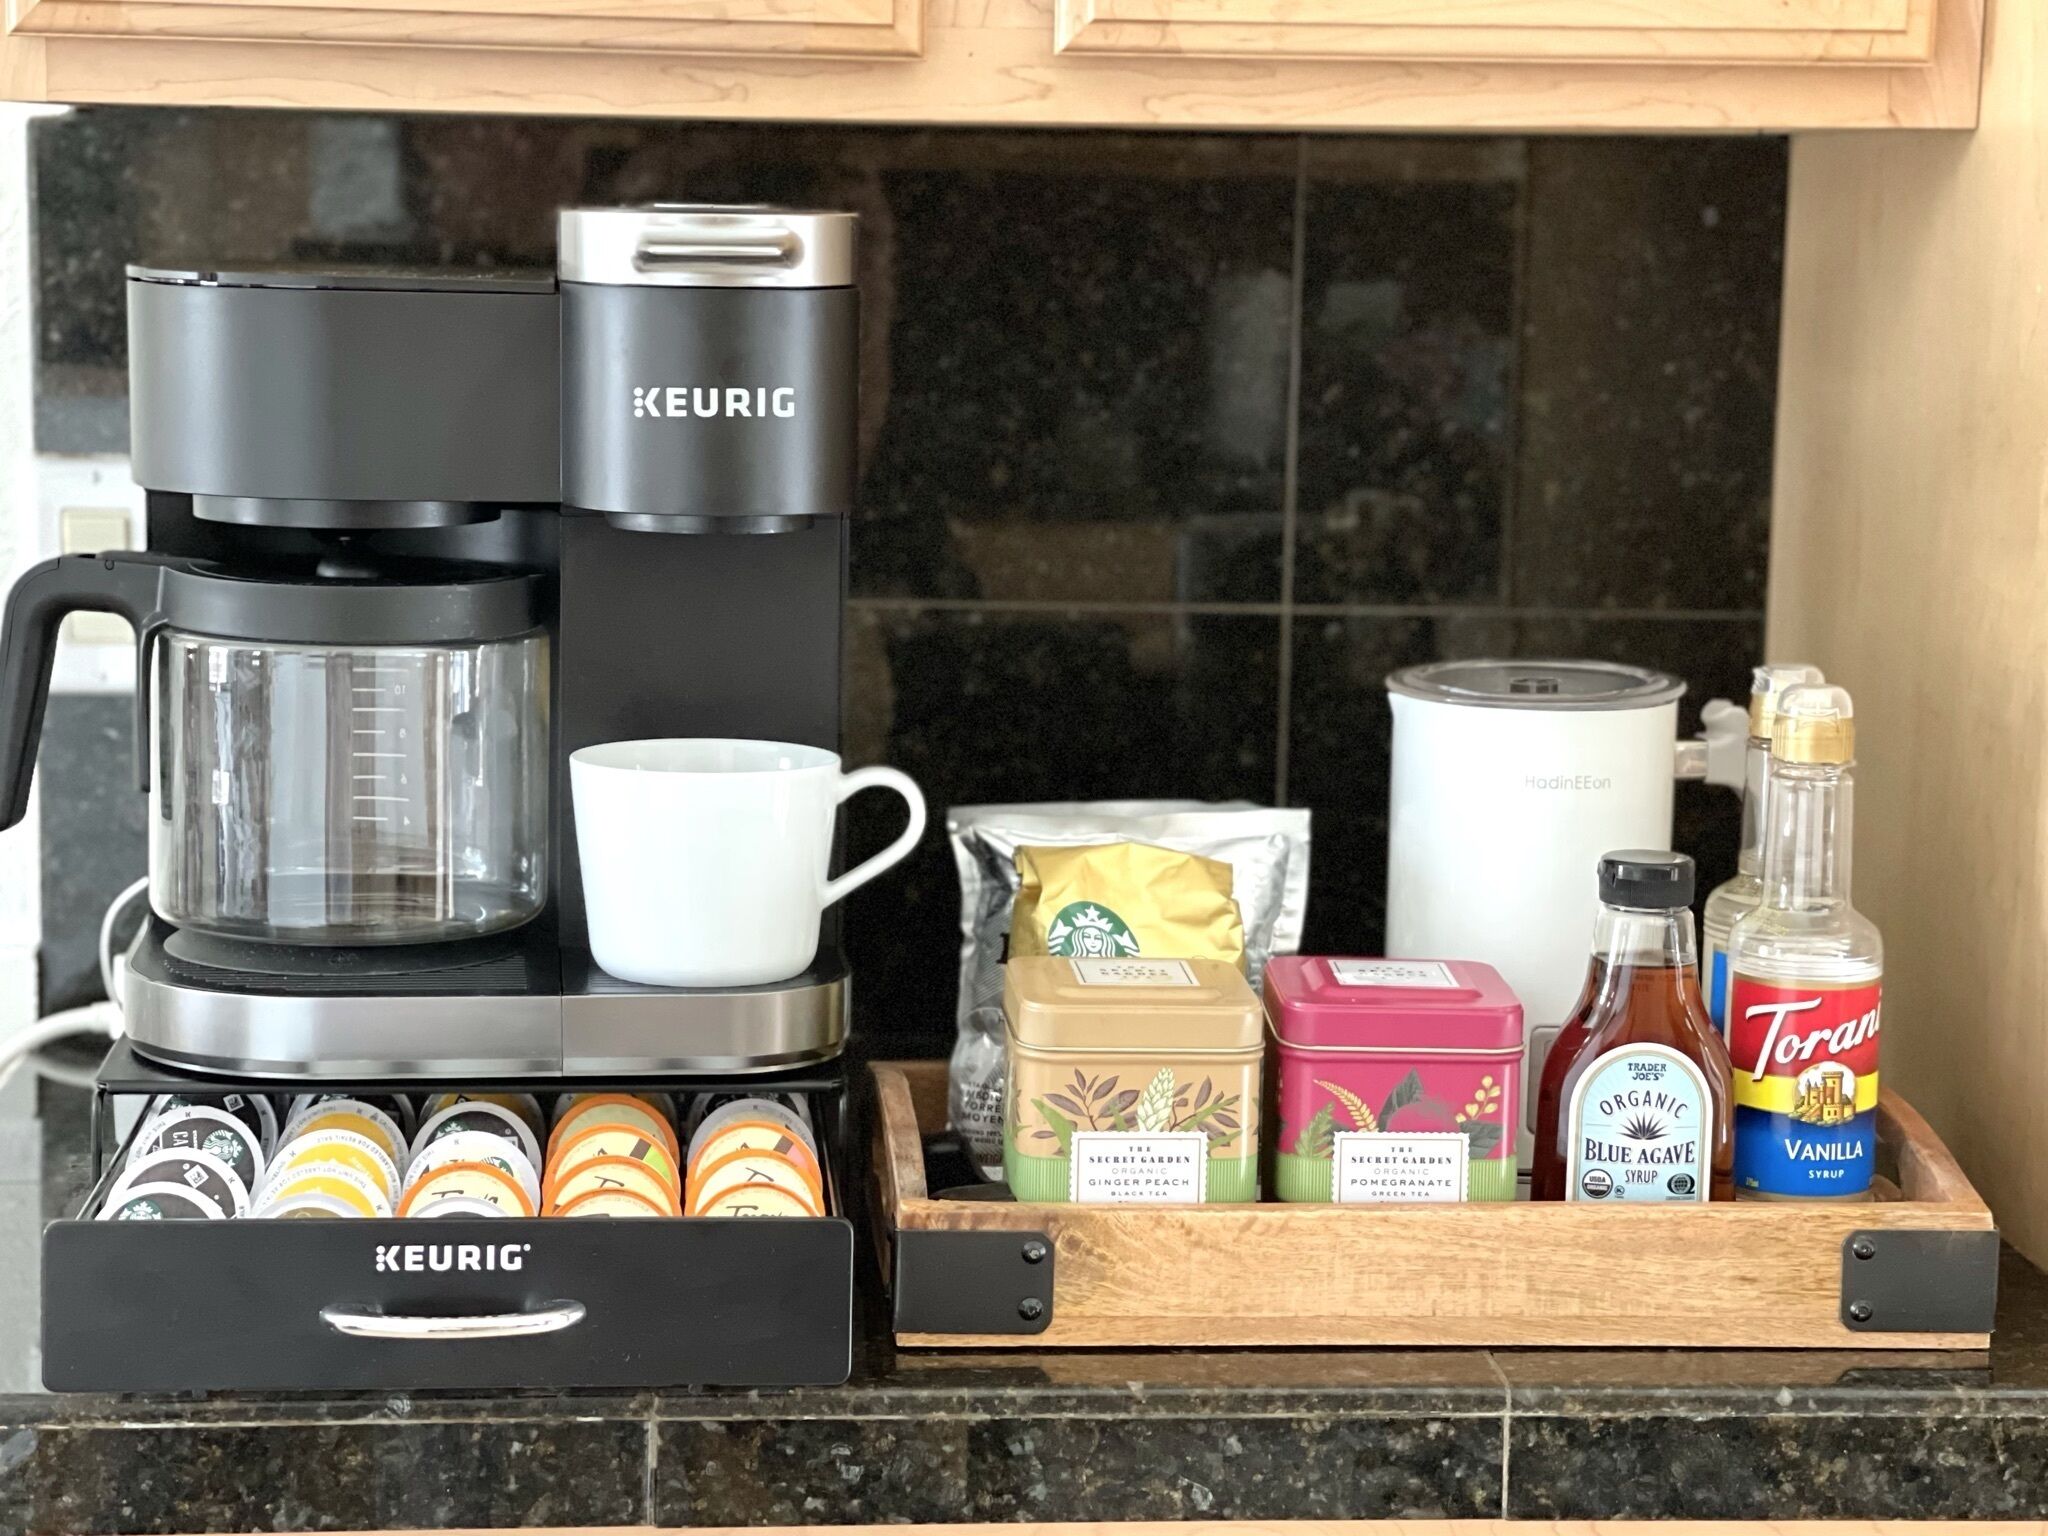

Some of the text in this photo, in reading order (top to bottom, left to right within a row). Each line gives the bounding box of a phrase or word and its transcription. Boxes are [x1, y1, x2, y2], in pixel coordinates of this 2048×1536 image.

[633, 386, 796, 418] KEURIG
[1525, 775, 1612, 790] HadinEEon
[1627, 1063, 1667, 1072] TRADER
[1599, 1090, 1688, 1119] ORGANIC
[1585, 1137, 1696, 1164] BLUE AGAVE
[1784, 1138, 1863, 1161] VANILLA
[1140, 1156, 1191, 1164] GARDEN
[1351, 1156, 1452, 1164] SECRET GARDEN
[1111, 1167, 1168, 1175] ORGANIC
[1625, 1169, 1658, 1184] SYRUP
[1808, 1169, 1845, 1179] SYRUP
[1088, 1178, 1189, 1186] GINGER PEACH
[1351, 1178, 1452, 1187] POMEGRANATE
[376, 1244, 522, 1272] KEURIG
